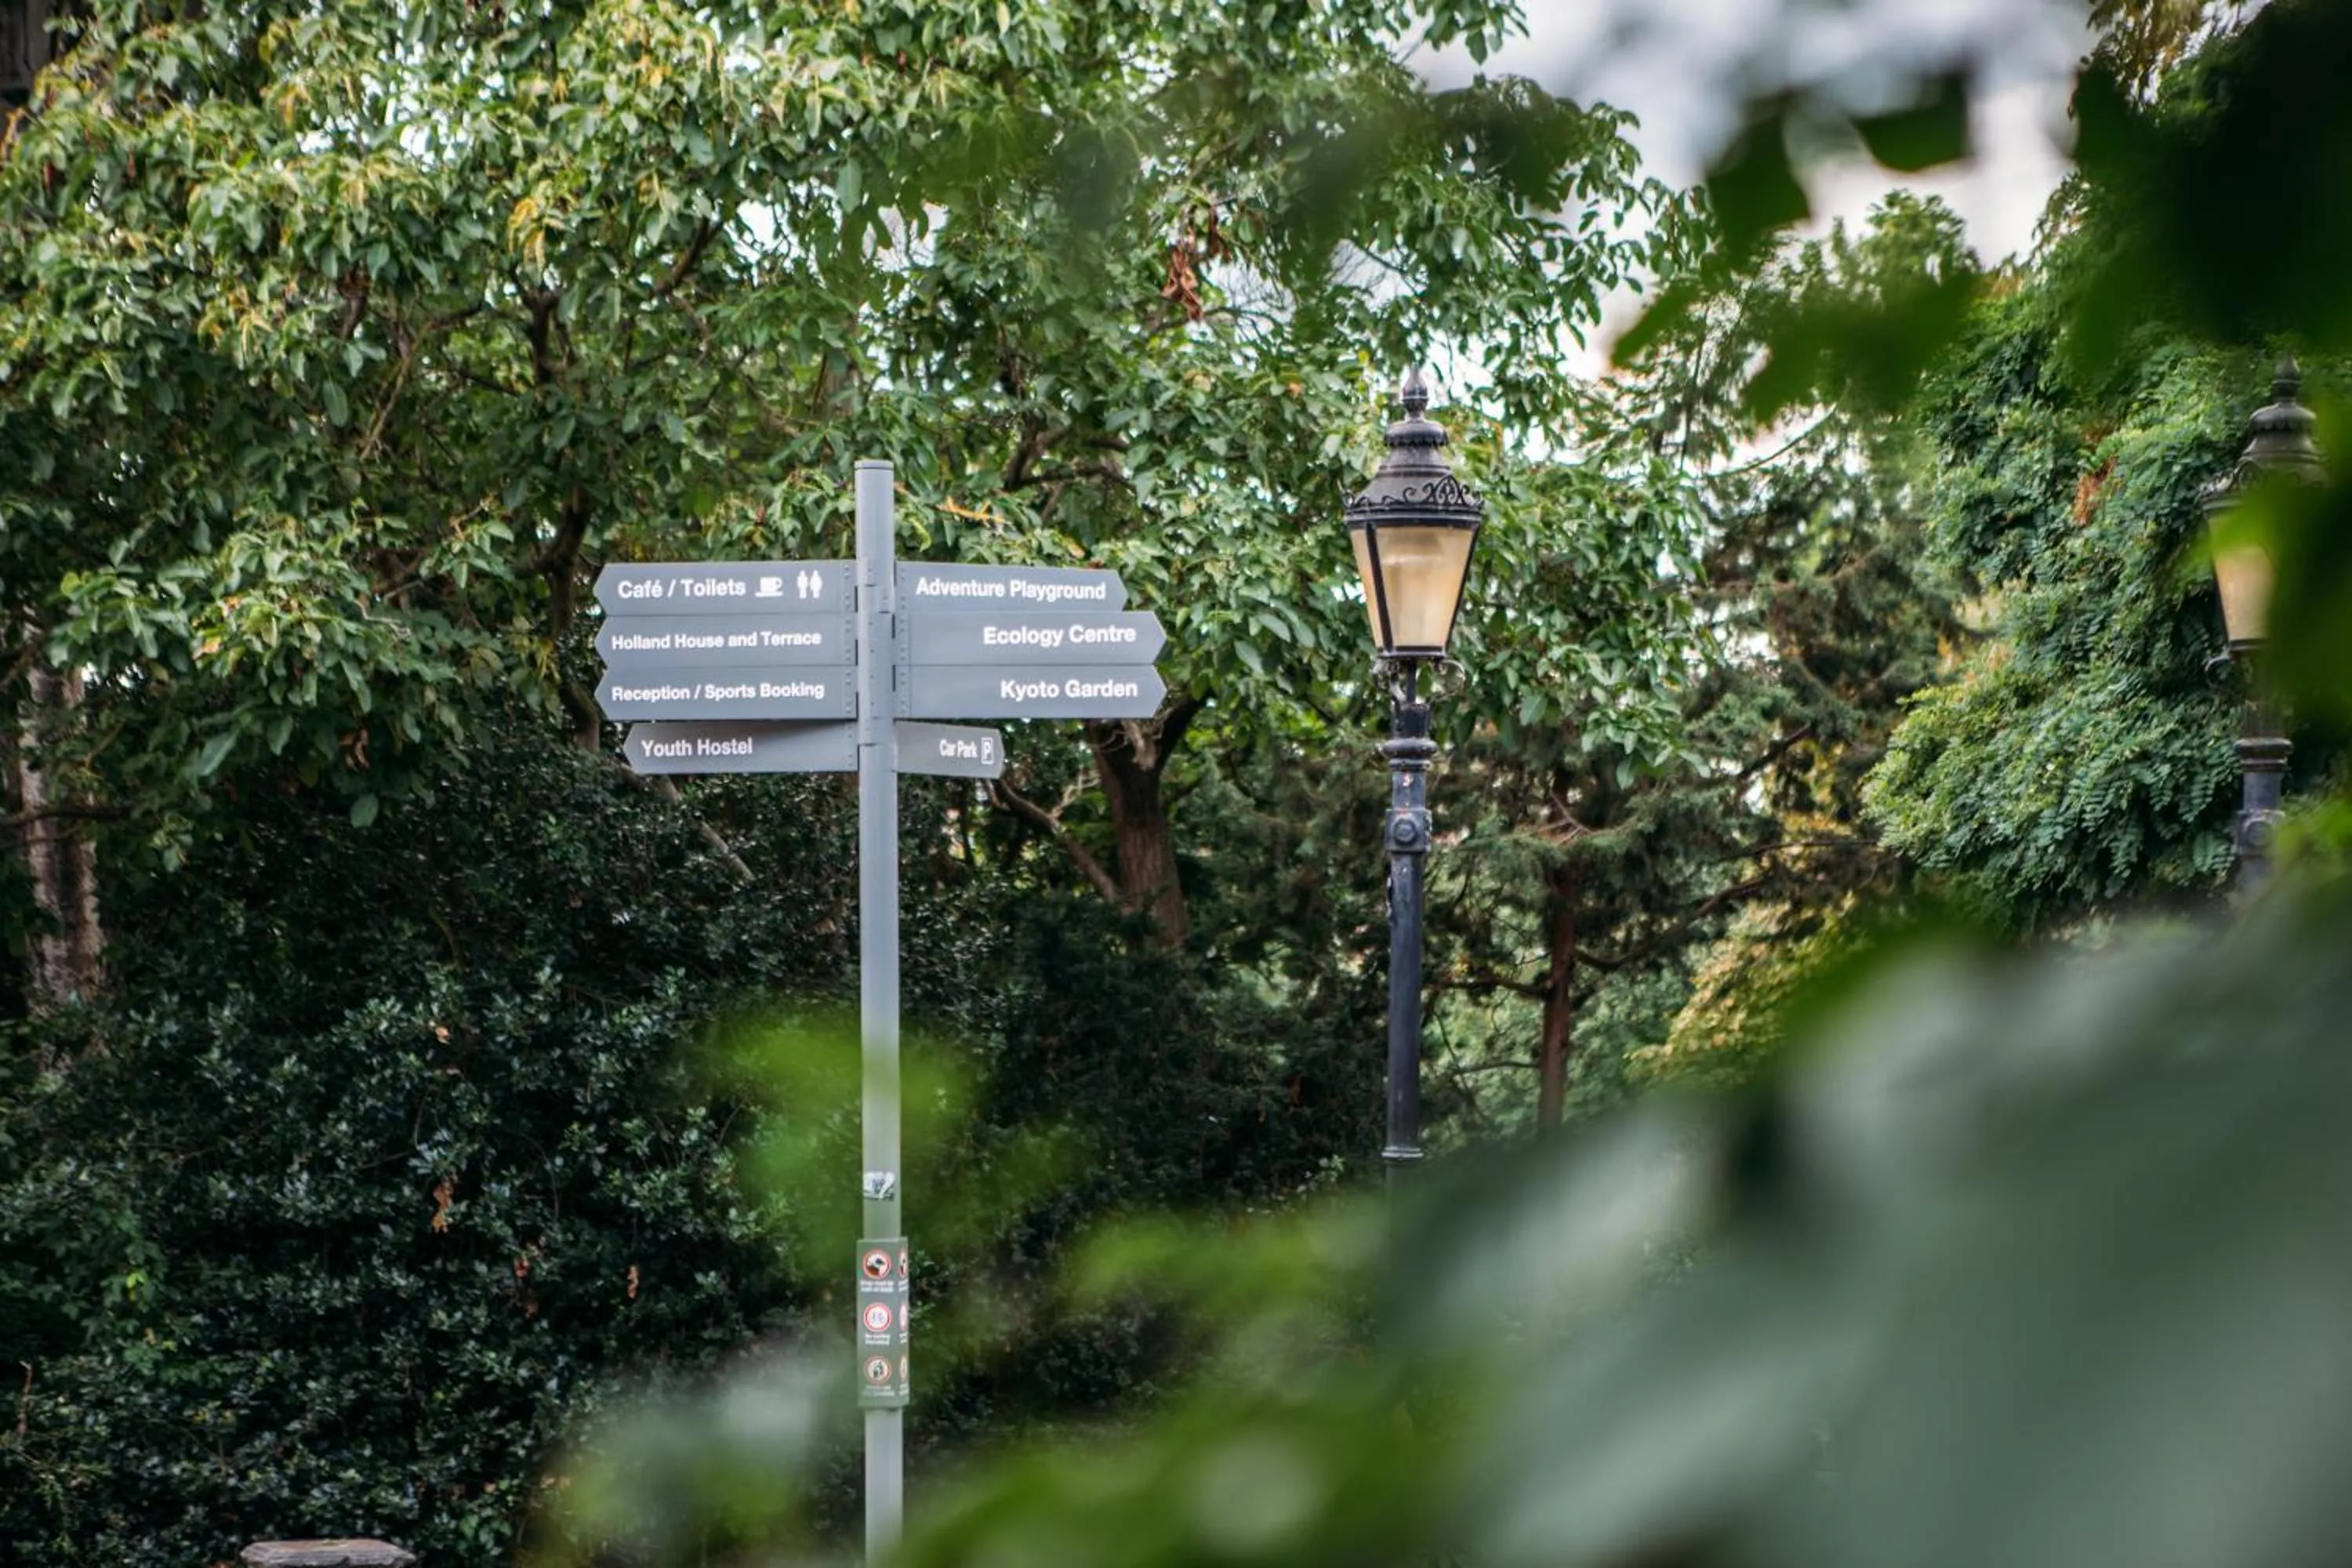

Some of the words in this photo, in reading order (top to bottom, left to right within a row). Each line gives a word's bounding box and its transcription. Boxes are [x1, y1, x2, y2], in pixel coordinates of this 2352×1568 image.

[619, 579, 662, 598] Café
[668, 579, 676, 597] /
[681, 579, 746, 596] Toilets
[916, 577, 1005, 597] Adventure
[1010, 579, 1105, 602] Playground
[612, 634, 670, 650] Holland
[675, 634, 724, 648] House
[728, 632, 757, 646] and
[760, 631, 822, 646] Terrace
[984, 626, 1063, 647] Ecology
[1069, 625, 1136, 643] Centre
[612, 685, 690, 702] Reception
[694, 684, 701, 699] /
[706, 684, 756, 701] Sports
[760, 682, 824, 699] Booking
[1001, 680, 1059, 702] Kyoto
[1065, 679, 1138, 698] Garden
[641, 740, 691, 757] Youth
[698, 738, 753, 756] Hostel
[939, 739, 956, 756] Car
[957, 739, 978, 757] Park
